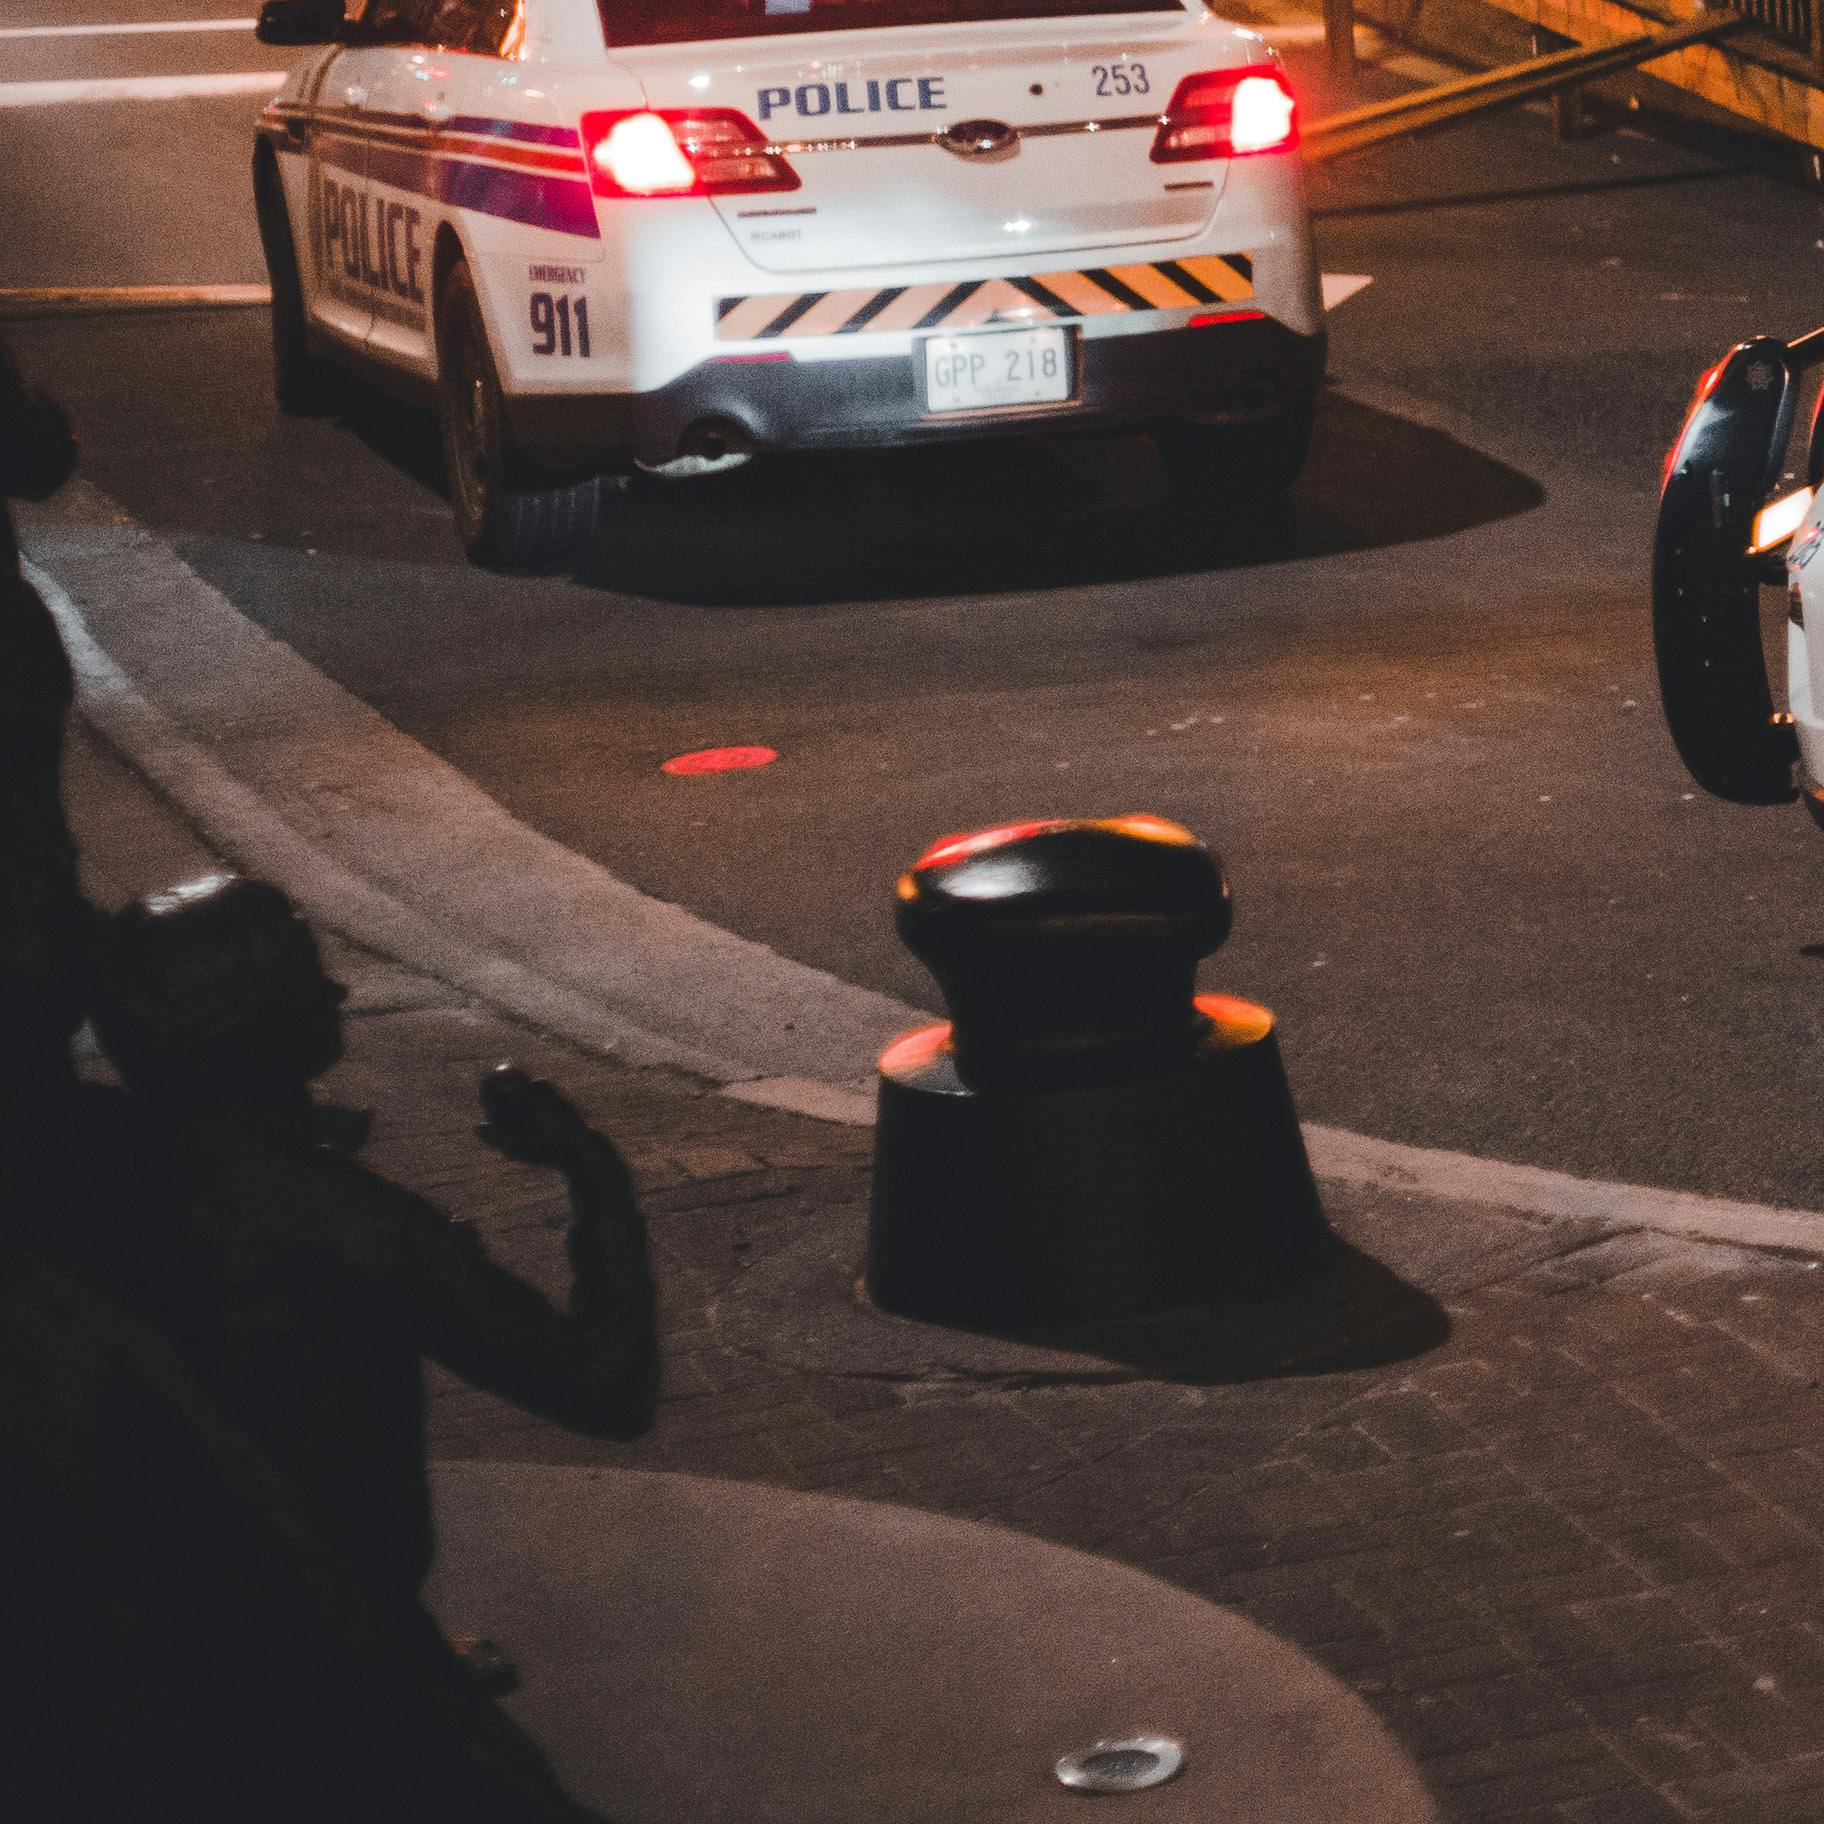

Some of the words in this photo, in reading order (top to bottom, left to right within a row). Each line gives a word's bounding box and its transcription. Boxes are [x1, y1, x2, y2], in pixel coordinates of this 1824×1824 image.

[757, 76, 947, 121] POLICE
[1091, 63, 1151, 98] 253
[323, 178, 424, 304] POLICE
[529, 264, 586, 286] EMERGENCY
[530, 291, 590, 358] 911
[934, 353, 985, 389] GPP
[1005, 347, 1059, 383] 218
